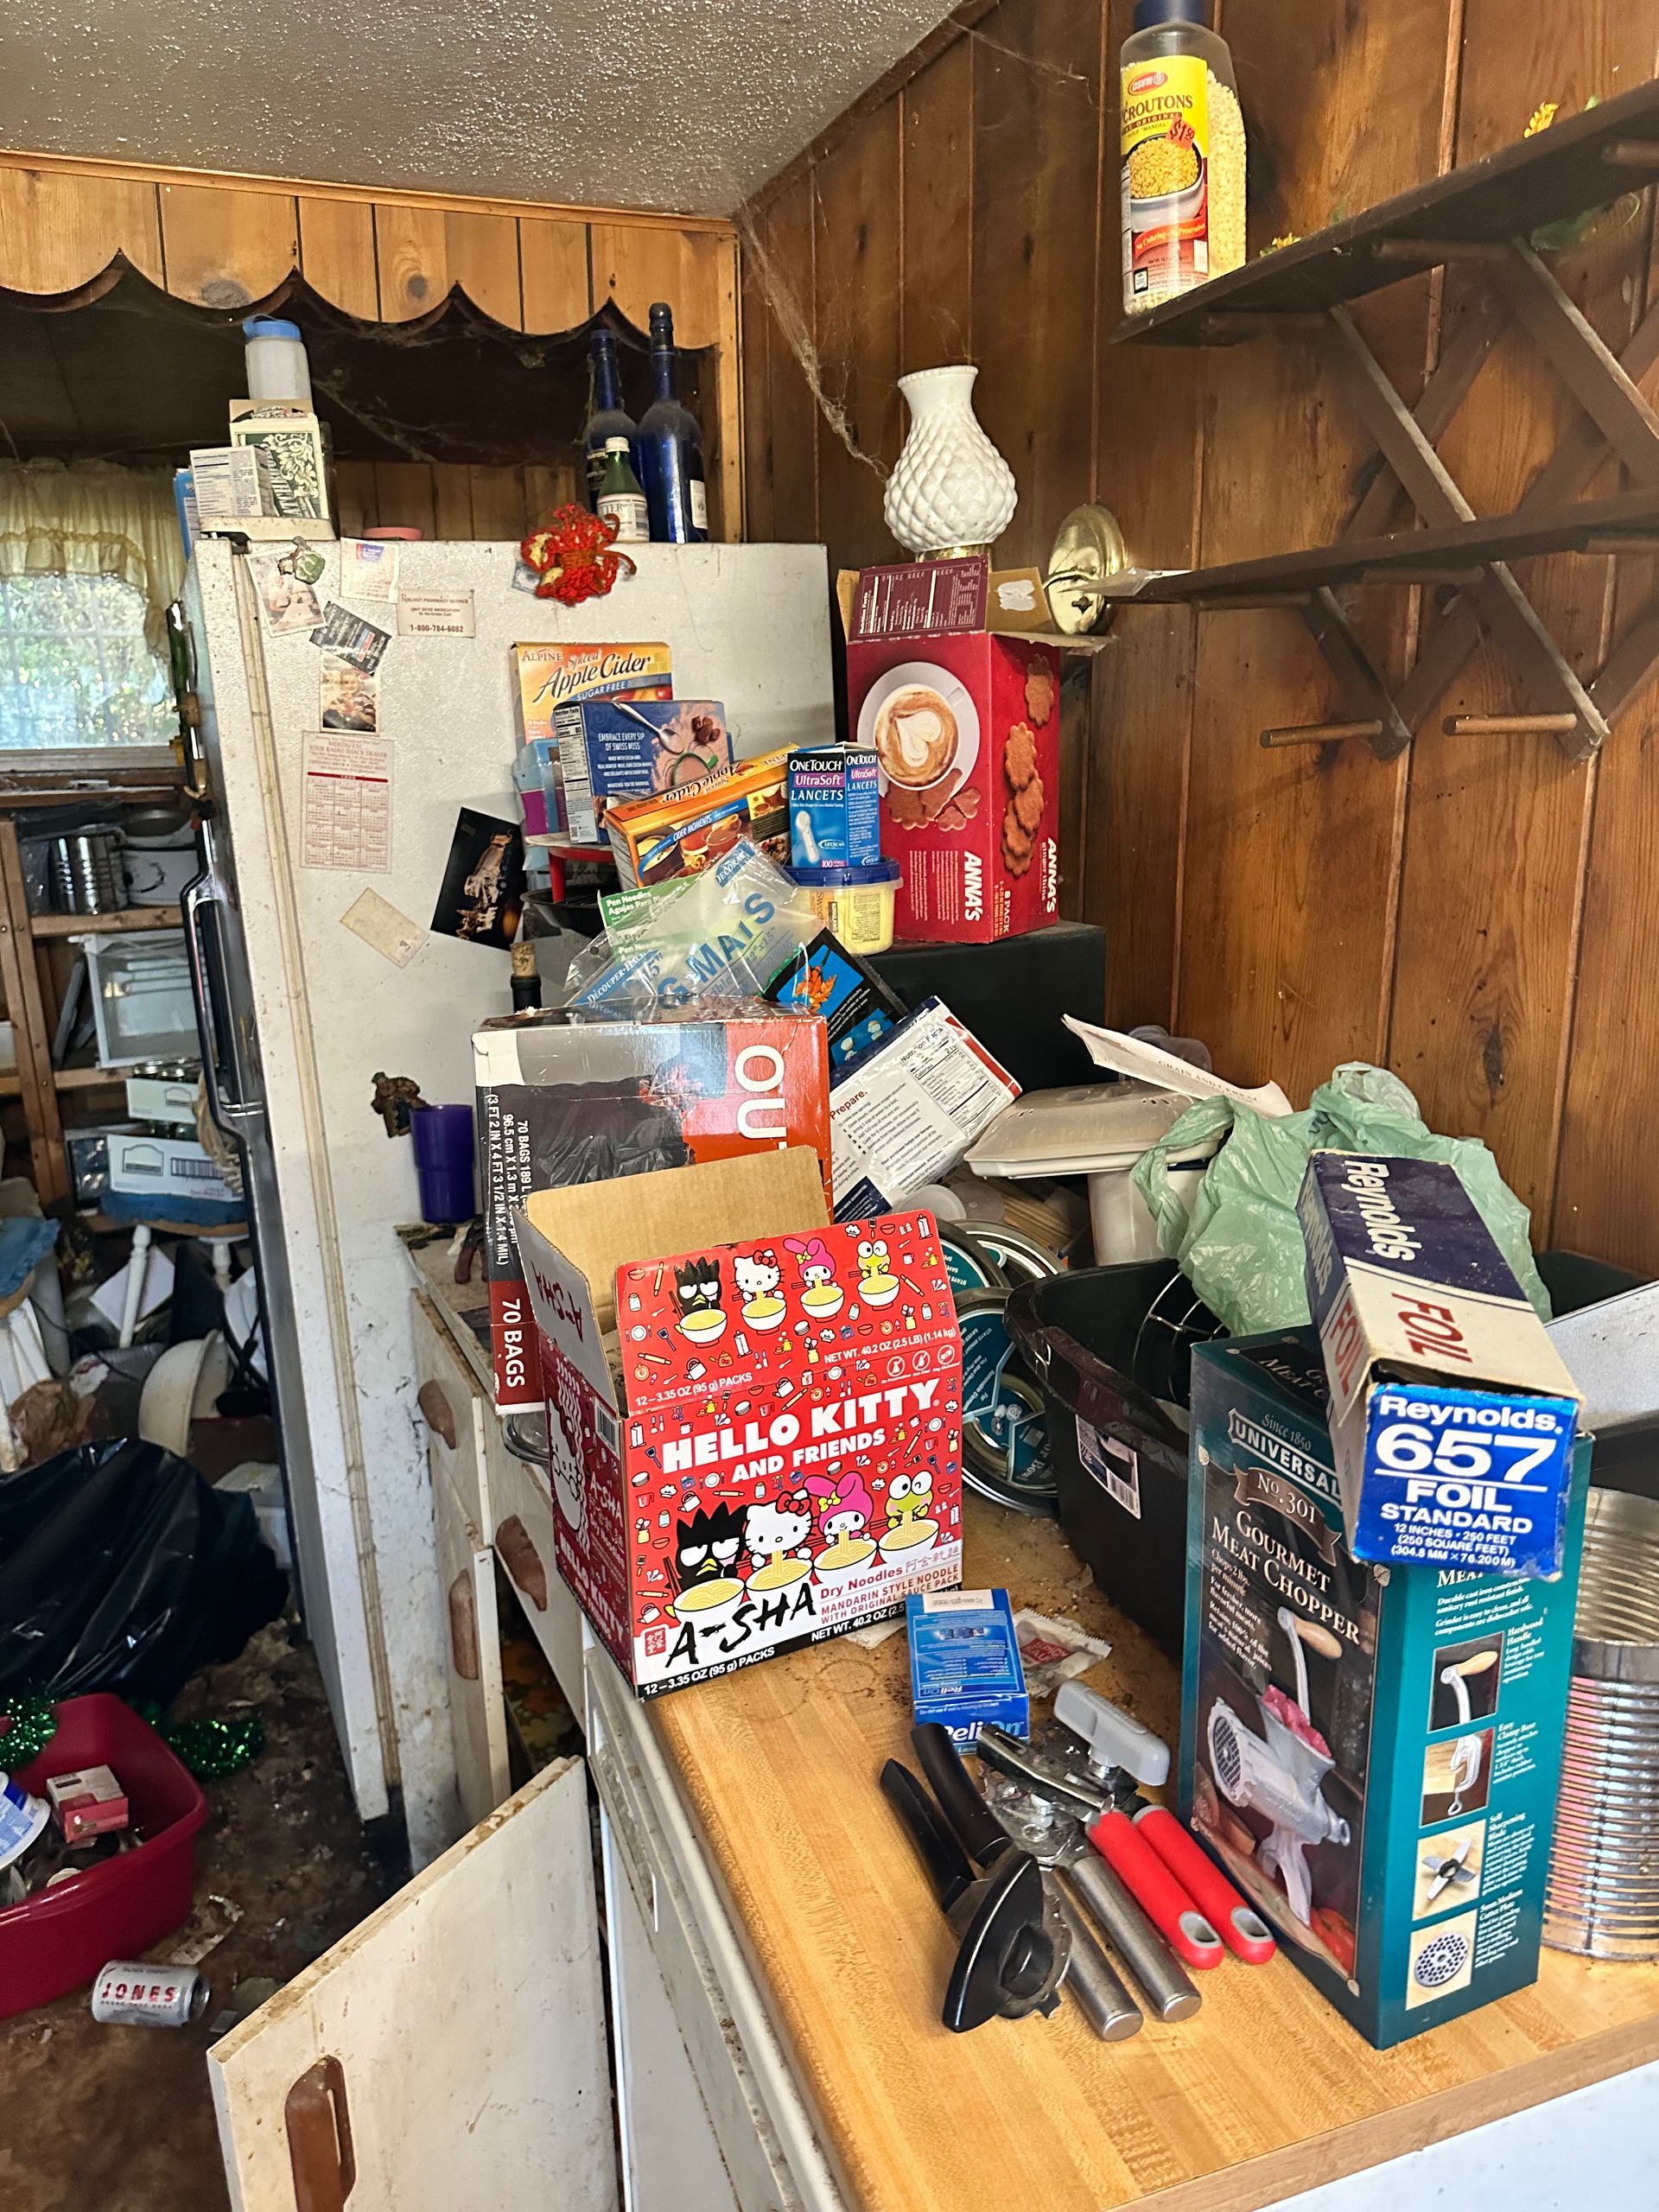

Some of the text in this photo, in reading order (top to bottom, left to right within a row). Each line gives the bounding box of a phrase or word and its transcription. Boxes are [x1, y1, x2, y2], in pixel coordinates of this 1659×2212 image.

[1123, 94, 1193, 124] CROUTONS
[522, 650, 562, 662] ALPINE
[567, 649, 602, 670] Spiced
[532, 652, 652, 702] Apple Cider
[576, 681, 626, 702] SUGAR FREE
[575, 726, 582, 734] 80
[598, 733, 637, 741] EMBRACE EVERY
[613, 742, 627, 751] SWISS
[795, 775, 842, 785] UltraSoft
[851, 768, 876, 778] UltraSoft
[663, 784, 701, 804] Cider
[791, 790, 843, 800] LANCETS
[848, 780, 877, 791] LANCETS
[673, 814, 713, 842] CIDER MOMENTS
[963, 849, 982, 922] ANNA'S
[1046, 837, 1058, 913] ANNA'S
[606, 898, 621, 907] Pen
[622, 891, 652, 904] Needles
[608, 905, 635, 916] Agujas
[488, 1106, 500, 1119] FT
[830, 1090, 869, 1120] Prepare.
[490, 1129, 501, 1141] IN
[503, 1114, 515, 1136] 96.5
[491, 1141, 502, 1151] X
[492, 1152, 502, 1160] 4
[504, 1138, 515, 1154] cm
[518, 1120, 532, 1183] 70 BAGS 189
[492, 1161, 504, 1174] FT
[506, 1165, 518, 1181] 1.3
[494, 1184, 505, 1202] 1/2
[507, 1183, 518, 1193] m
[494, 1204, 506, 1215] IN
[495, 1216, 507, 1224] X
[1341, 1160, 1422, 1262] Reynolds
[496, 1226, 508, 1242] 1.4
[496, 1243, 509, 1267] MIL)
[1390, 1292, 1473, 1363] FOIL
[502, 1299, 526, 1389] 70 BAGS
[824, 1325, 957, 1364] NET WT. 40.2 OZ (2.5 LB) (1.14 kg)
[1330, 1300, 1363, 1397] FOIL
[635, 1371, 753, 1407] 12 3.35 OZ (95 PACKS
[662, 1378, 940, 1474] HELLO KITTY
[1262, 1413, 1312, 1452] Since 1850
[731, 1427, 886, 1484] AND FRIENDS
[1235, 1420, 1341, 1498] UNIVERSAL
[1376, 1423, 1557, 1483] 657
[1406, 1479, 1512, 1514] FOIL
[1286, 1492, 1317, 1526] 301
[1380, 1503, 1534, 1535] STANDARD
[1394, 1522, 1517, 1546] 12 INCHES 250 FEET
[1397, 1534, 1510, 1557] (250 SQUARE FEET)
[1236, 1510, 1331, 1593] GOURMET
[1390, 1544, 1448, 1561] (304.8 MM
[821, 1567, 902, 1599] Dry Noodles
[821, 1563, 958, 1615] MANDARIN STYLE NOODLE
[1211, 1515, 1360, 1645] MEAT CHOPPER
[1436, 1569, 1484, 1588] MEA
[822, 1573, 958, 1624] WITH ORIGINAL SAUCE PACK
[665, 1582, 817, 1668] A-SHA
[810, 1605, 905, 1643] NET WT. 40.2 OZ (2.5
[644, 1647, 774, 1695] 12 3.35 OZ (95 g) PACKS
[102, 1982, 177, 2003] JONES
